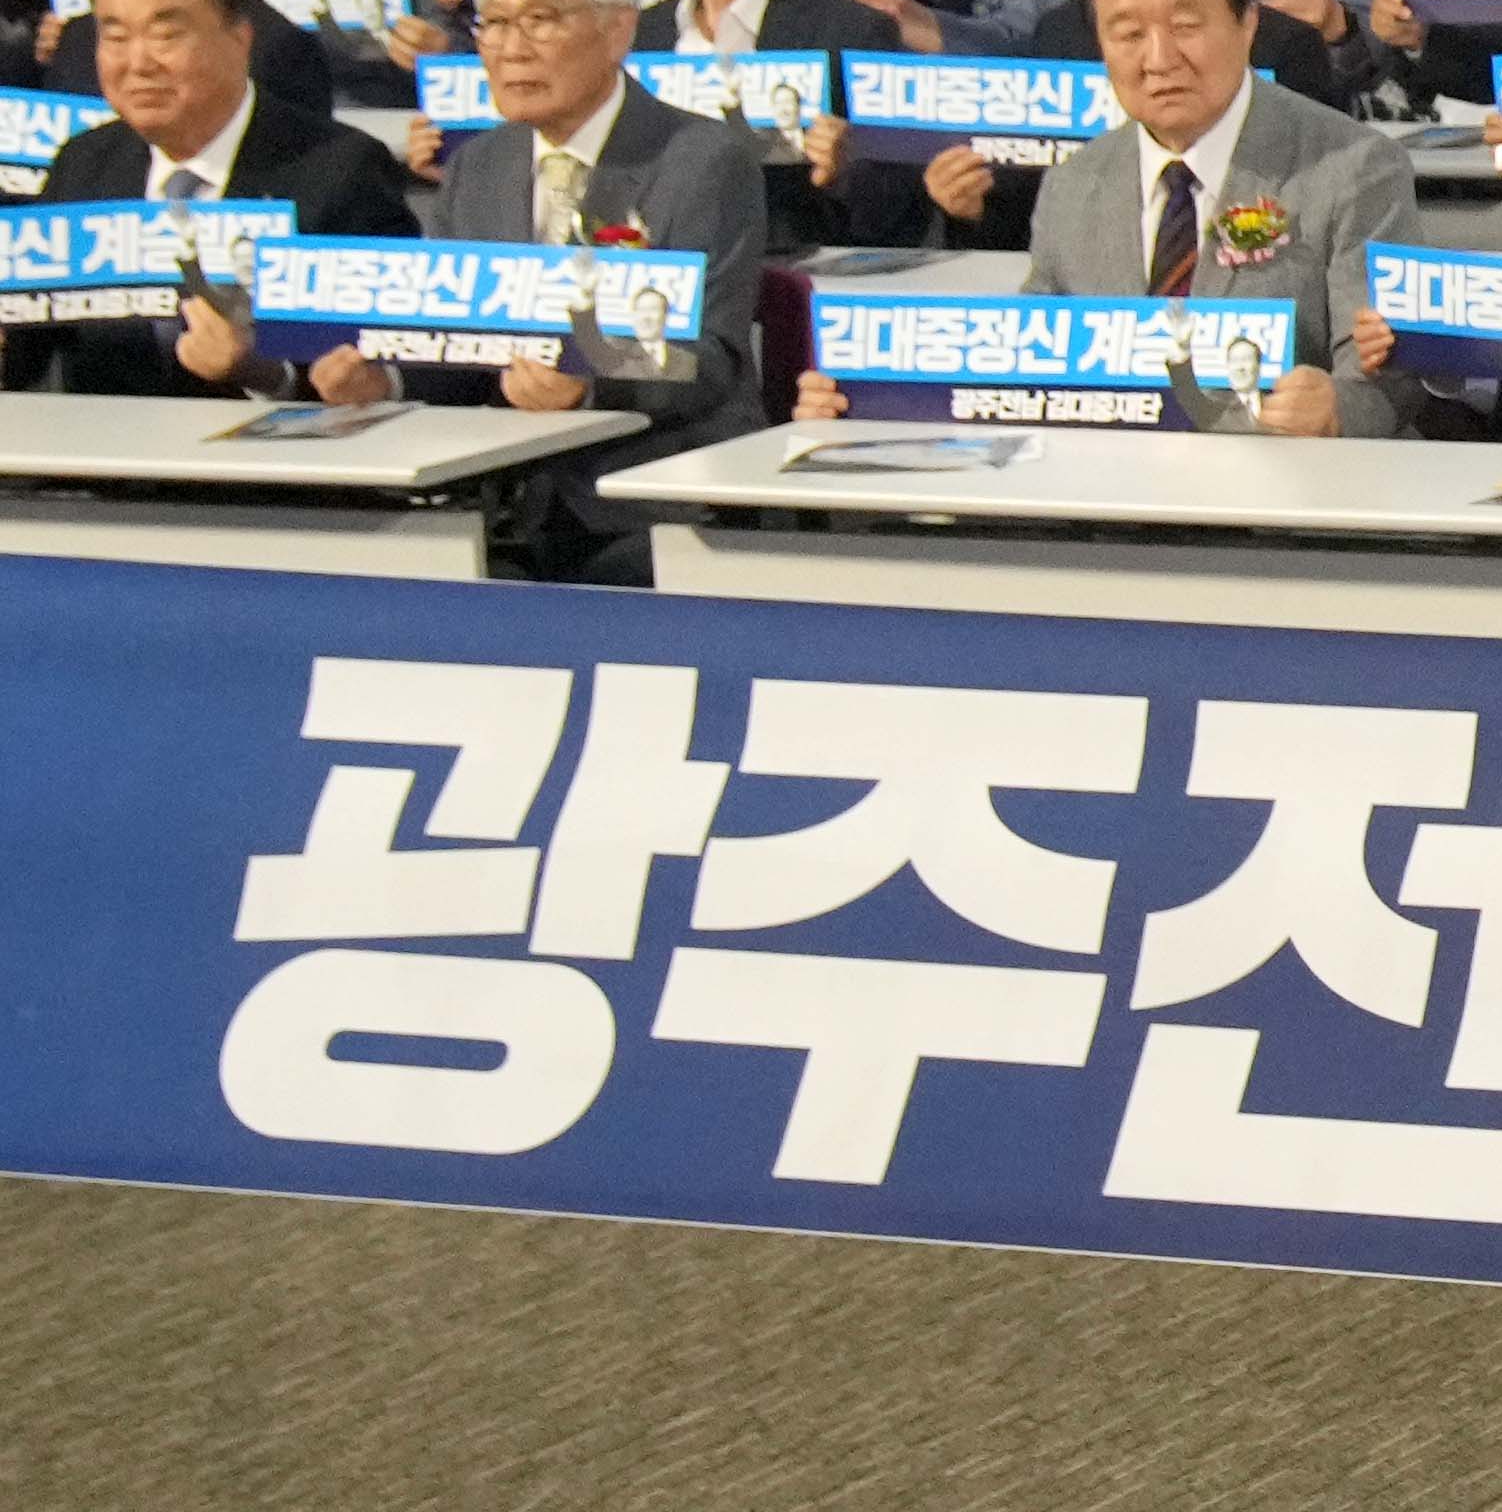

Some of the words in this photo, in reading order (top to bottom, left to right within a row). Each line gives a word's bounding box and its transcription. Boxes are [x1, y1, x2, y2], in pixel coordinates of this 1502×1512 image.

[851, 65, 1070, 129] 김대중정신
[259, 246, 478, 317] 김대중정신
[482, 255, 699, 331] 계승발전
[818, 305, 1068, 374] 김대중정신
[1079, 311, 1287, 378] 계승발전
